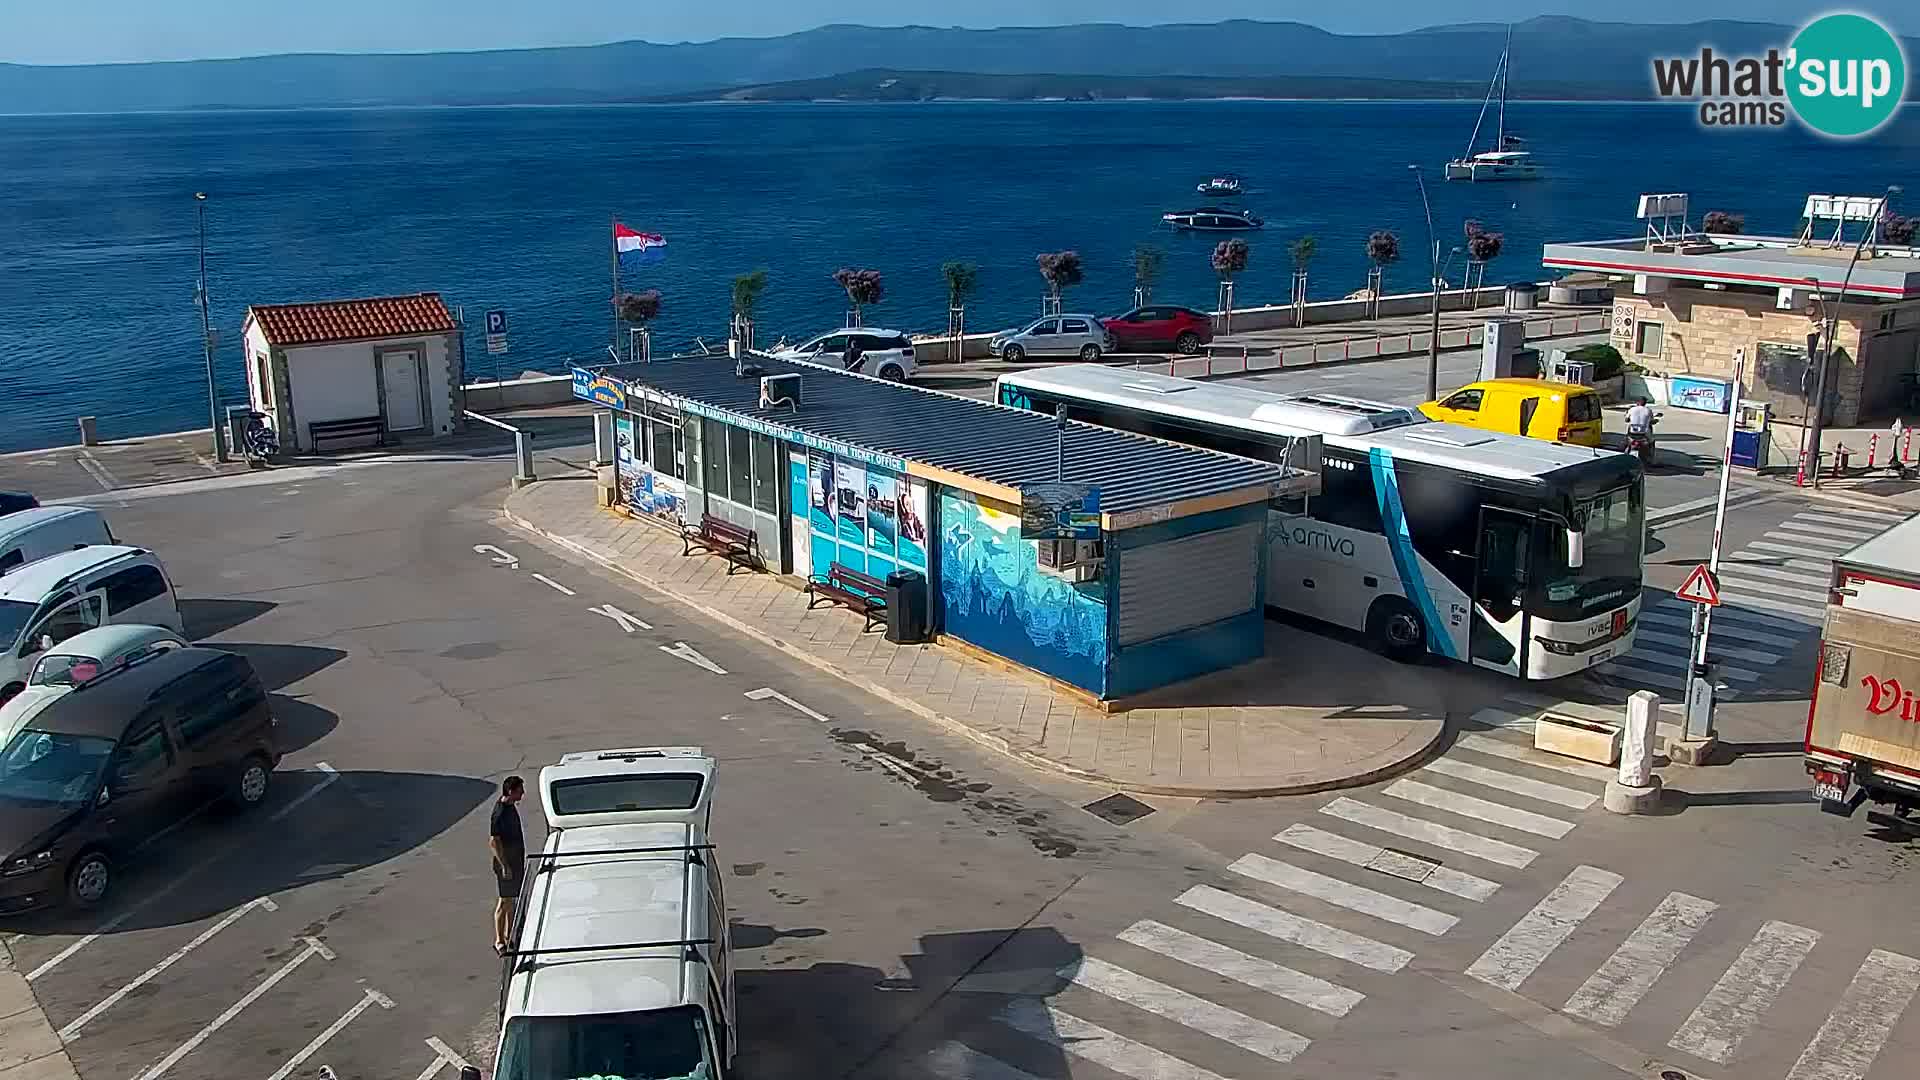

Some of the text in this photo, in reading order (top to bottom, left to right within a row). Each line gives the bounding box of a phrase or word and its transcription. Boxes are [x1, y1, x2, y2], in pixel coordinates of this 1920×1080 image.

[490, 314, 501, 331] P
[803, 435, 816, 446] BUS
[819, 440, 848, 456] STATION
[851, 448, 874, 463] TICKET
[876, 456, 901, 471] OFFICE
[1293, 528, 1354, 556] arriva
[1587, 620, 1611, 637] IVEC
